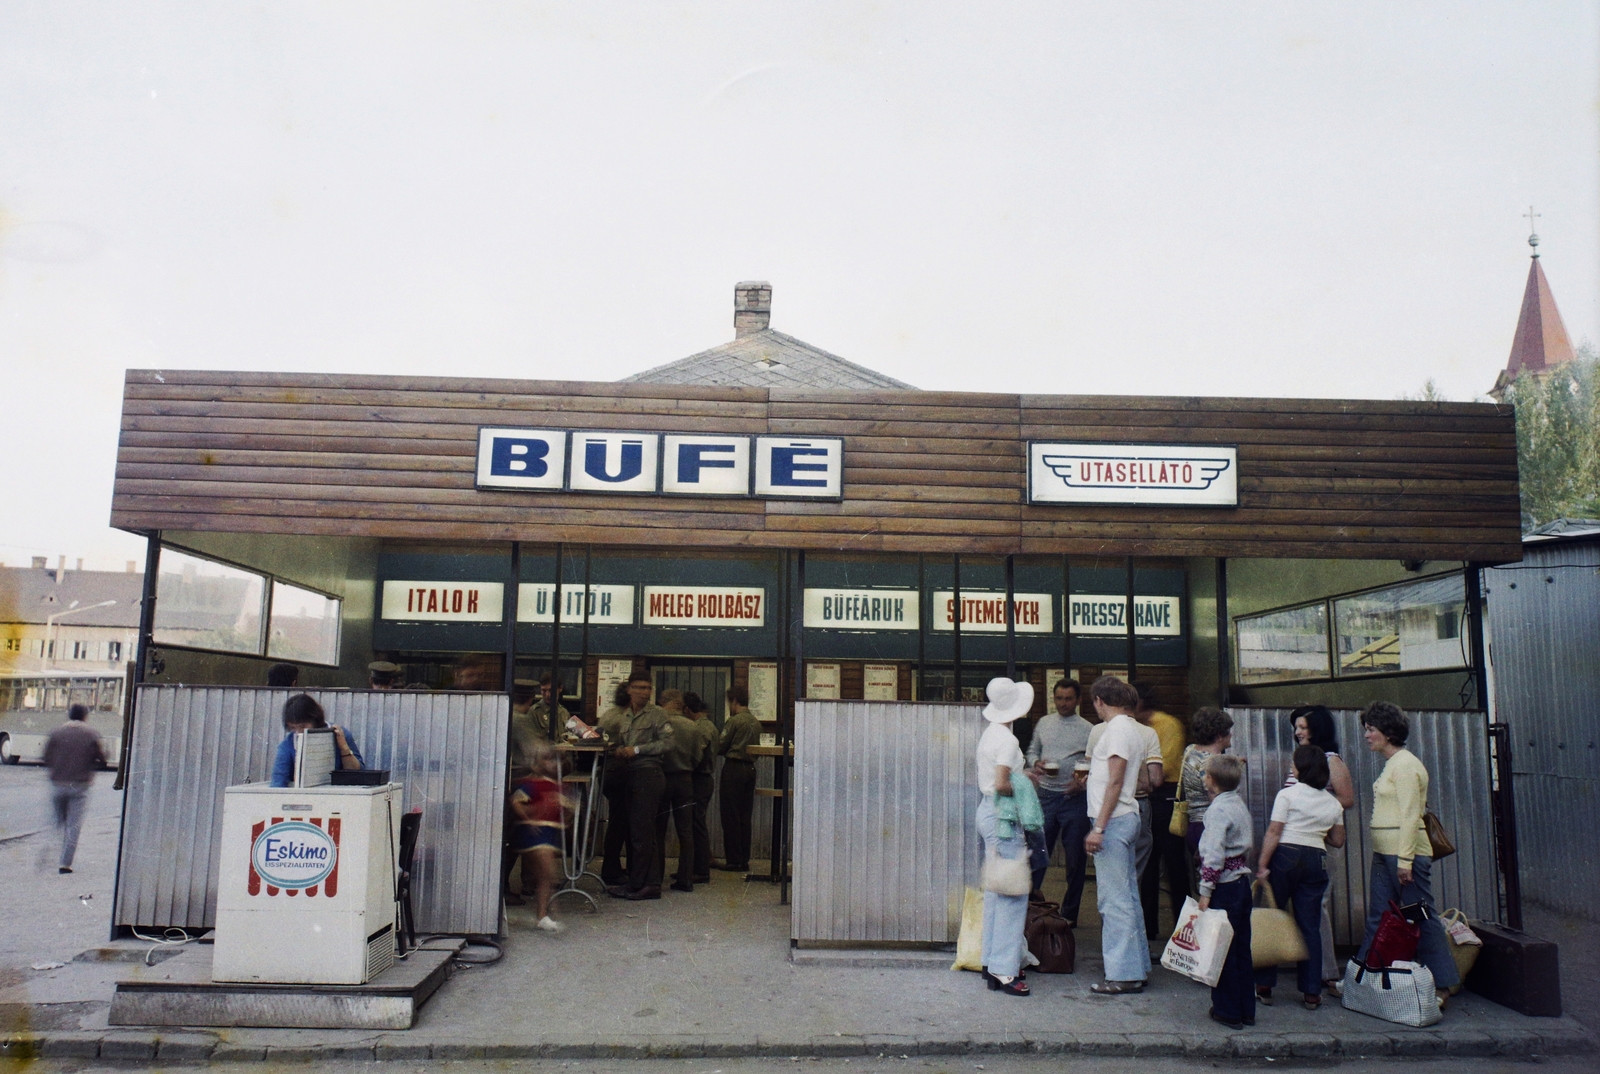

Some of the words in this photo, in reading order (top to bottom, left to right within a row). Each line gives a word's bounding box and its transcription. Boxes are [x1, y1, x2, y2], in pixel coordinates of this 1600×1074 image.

[490, 437, 828, 487] BÜFÉ
[1080, 461, 1192, 483] UTASELLÁTÓ
[408, 588, 479, 613] ITALOK
[649, 593, 693, 618] MELEG
[697, 591, 761, 620] KOLBÁSZ
[823, 593, 904, 622] BÜFÉÁRUK
[1072, 601, 1170, 627] PRESSZKÁVÉ
[265, 839, 328, 861] Eskimo
[1179, 927, 1194, 943] HB
[1167, 948, 1177, 957] The
